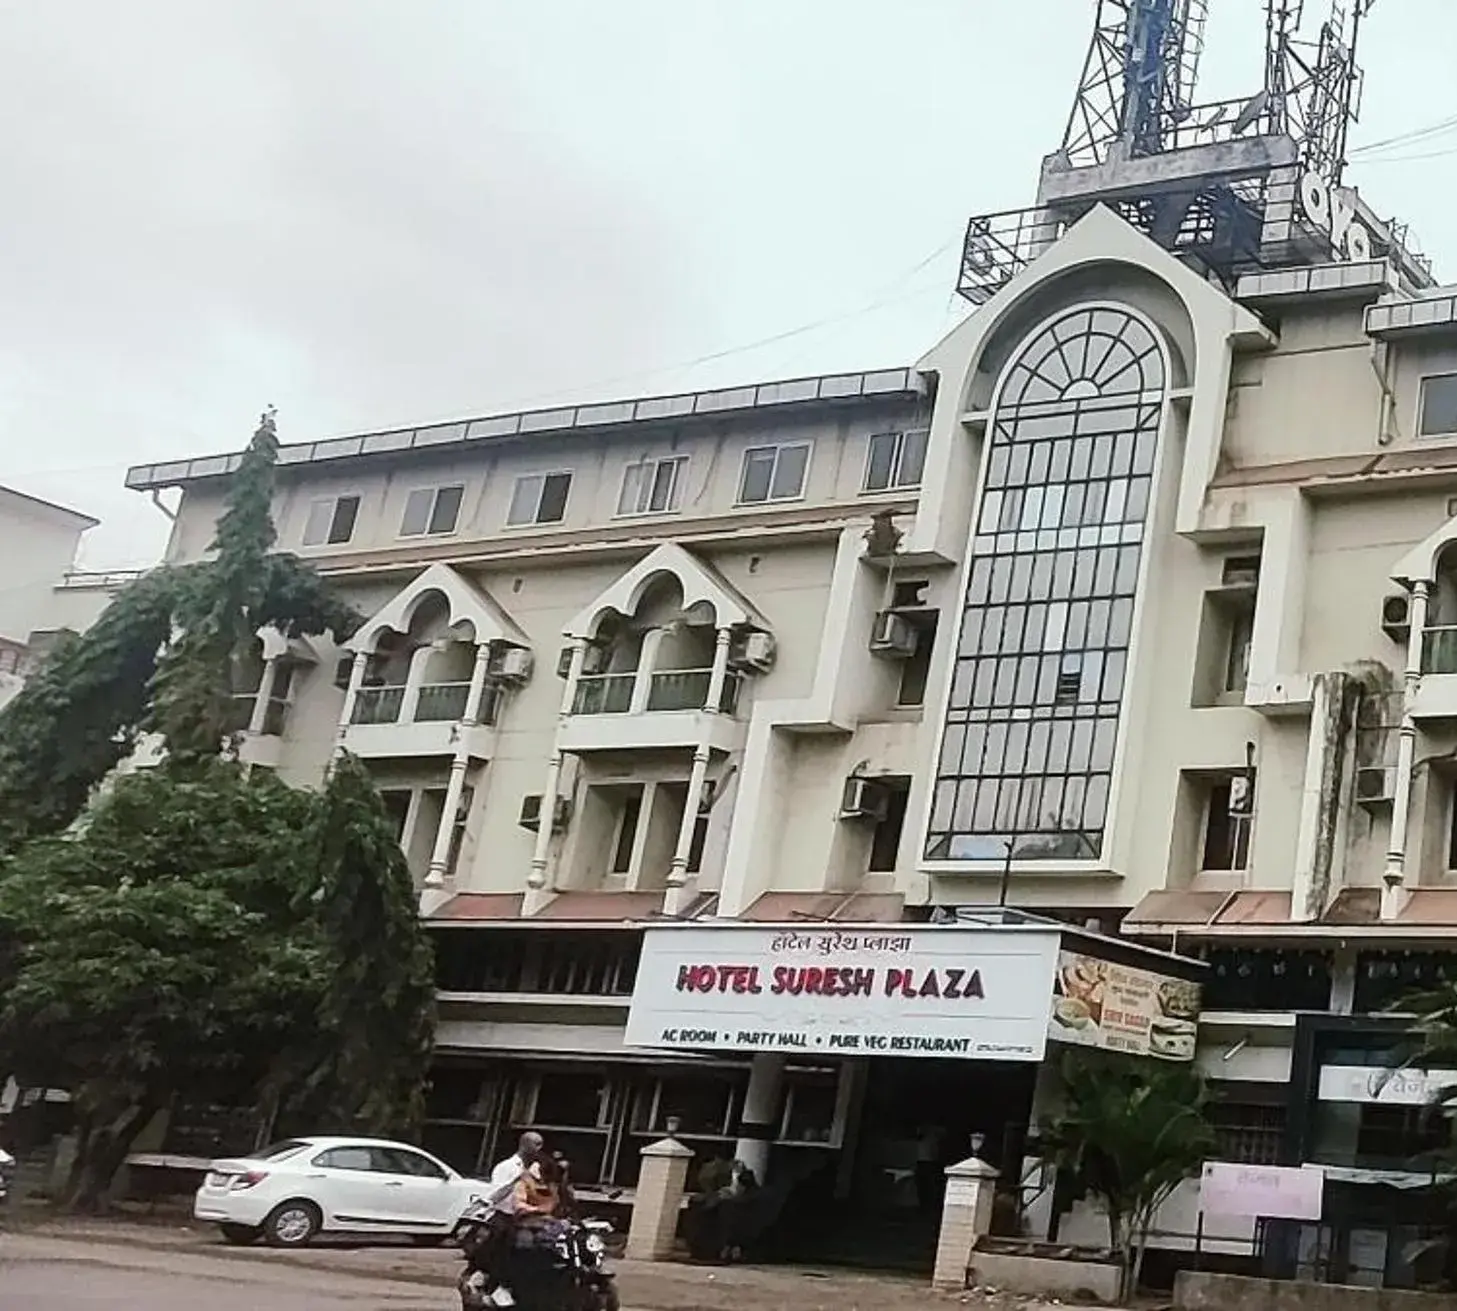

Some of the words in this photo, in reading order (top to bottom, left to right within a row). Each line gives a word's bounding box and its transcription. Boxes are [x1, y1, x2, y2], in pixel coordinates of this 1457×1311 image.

[676, 965, 762, 994] HOTEL
[771, 966, 875, 997] SURESH
[885, 968, 985, 999] PLAZA
[662, 1029, 678, 1042] AC
[680, 1030, 717, 1044] ROOM
[736, 1031, 778, 1046] PARTY
[778, 1033, 807, 1048] HALL
[829, 1034, 860, 1048] PURE
[863, 1035, 887, 1050] VEG
[890, 1036, 970, 1052] RESTAURANT
